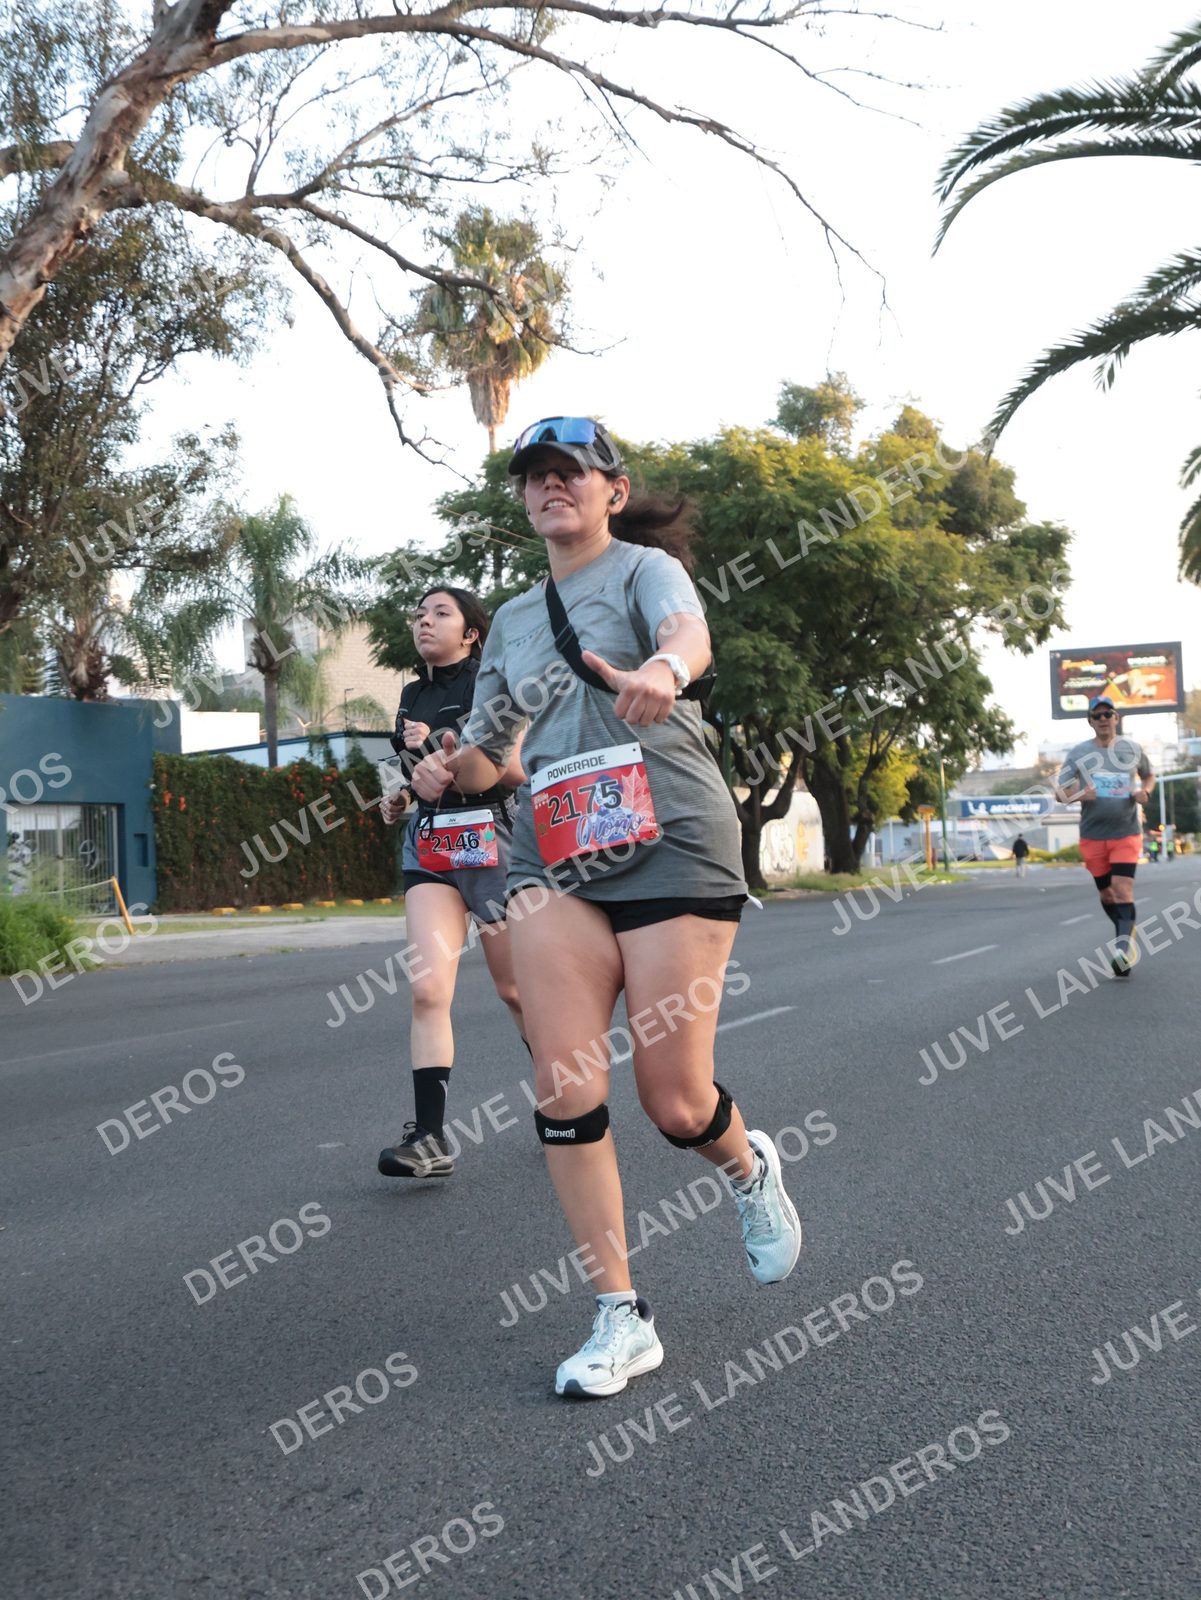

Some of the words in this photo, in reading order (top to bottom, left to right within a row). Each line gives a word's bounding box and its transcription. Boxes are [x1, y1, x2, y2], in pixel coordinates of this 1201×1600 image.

[547, 755, 606, 781] POWERADE
[547, 779, 623, 827] 2175
[431, 832, 480, 853] 2146
[545, 1127, 576, 1139] GOUNOD
